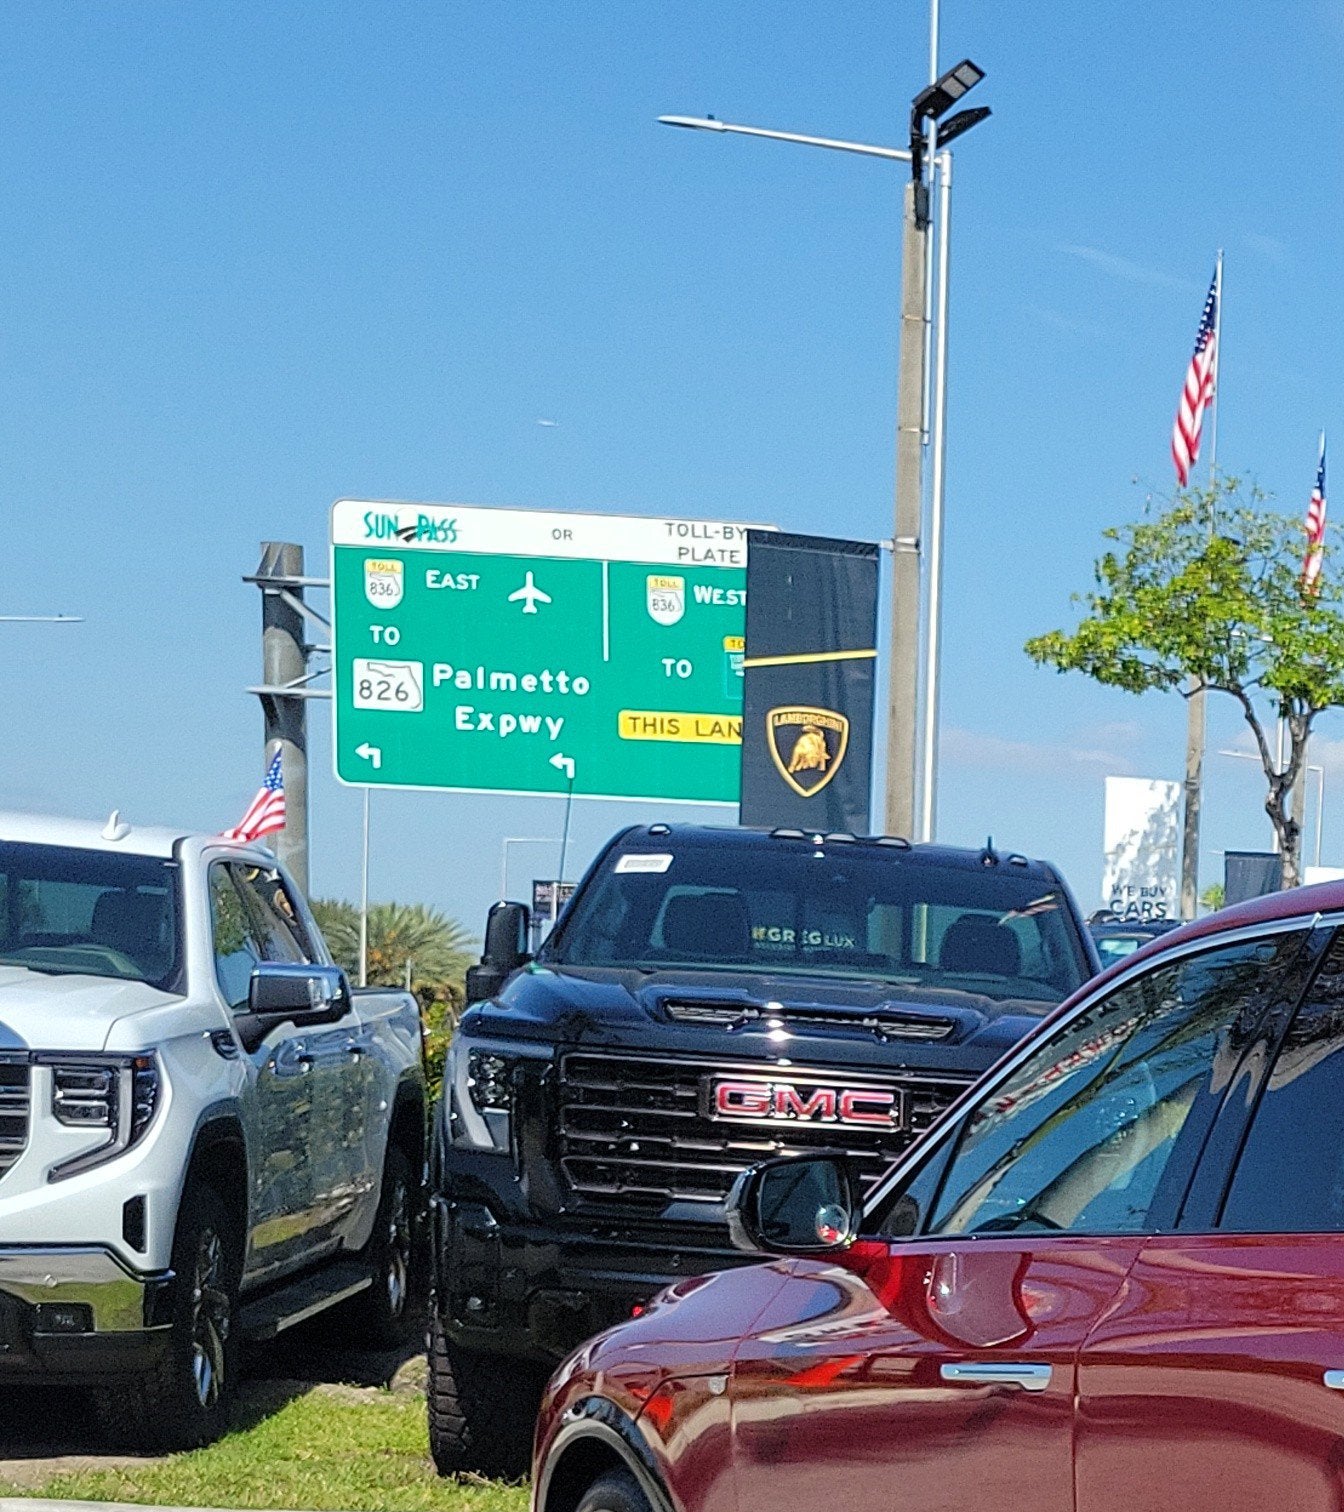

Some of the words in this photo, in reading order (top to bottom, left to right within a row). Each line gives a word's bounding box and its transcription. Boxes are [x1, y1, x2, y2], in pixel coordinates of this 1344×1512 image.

[551, 527, 573, 542] OR
[678, 546, 741, 564] PLATE
[370, 582, 393, 596] 836
[425, 569, 481, 592] EAST
[652, 598, 675, 612] 836
[369, 625, 401, 647] TO
[433, 663, 591, 696] Palmetto
[662, 658, 693, 680] TO
[358, 679, 411, 703] 826
[454, 706, 565, 742] Expwy
[628, 716, 681, 736] THIS
[1111, 883, 1134, 897] WE
[1140, 885, 1167, 898] BUY
[1110, 899, 1168, 918] CARS
[715, 1079, 896, 1124] GMC
